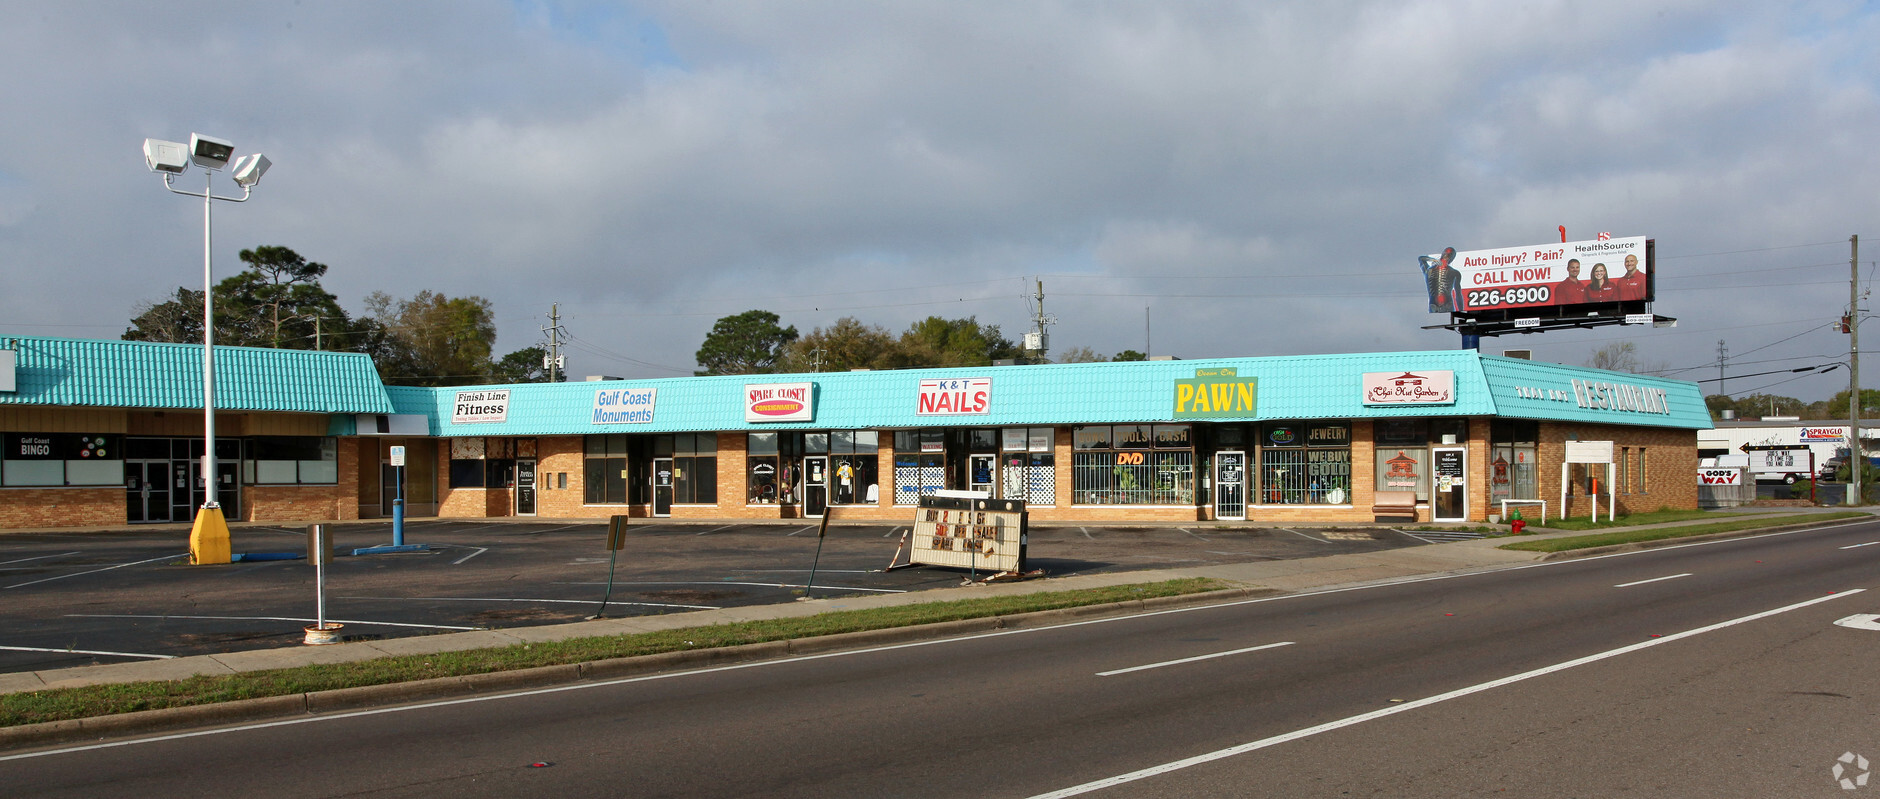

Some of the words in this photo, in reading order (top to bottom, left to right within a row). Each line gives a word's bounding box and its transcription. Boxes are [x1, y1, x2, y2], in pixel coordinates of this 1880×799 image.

[1575, 242, 1635, 252] HealthSource
[1464, 256, 1488, 267] Auto
[1491, 251, 1527, 266] Injury?
[1534, 248, 1564, 261] Pain?
[1473, 270, 1508, 285] CALL
[1513, 267, 1551, 282] NOW!
[1467, 285, 1550, 307] 226-6900
[1515, 318, 1540, 327] FREEDOM
[1196, 369, 1218, 377] Ocean
[1220, 368, 1236, 376] City
[939, 380, 948, 390] K
[950, 380, 959, 390] &
[962, 380, 970, 389] T
[458, 392, 485, 402] Finish
[487, 392, 507, 401] Line
[598, 391, 620, 406] Gulf
[622, 390, 652, 405] Coast
[749, 389, 774, 404] SPARE
[777, 387, 806, 402] CLOSET
[1176, 382, 1255, 412] PAWN
[1413, 386, 1439, 399] Garden
[1571, 378, 1670, 415] RESTAURANT
[919, 391, 987, 413] NAILS
[456, 403, 504, 415] Fitness
[593, 408, 652, 422] Monuments
[1115, 431, 1148, 443] TOOLS
[1160, 431, 1188, 442] CASH
[1309, 428, 1347, 440] JEWELRY
[1809, 427, 1843, 435] SPRAYGLO
[21, 444, 50, 455] BINGO
[1117, 452, 1144, 465] DVD
[1308, 450, 1325, 462] WE
[1327, 450, 1349, 462] BUY
[1308, 463, 1350, 476] GOLD
[1700, 473, 1738, 484] WAY
[943, 510, 949, 522] 2
